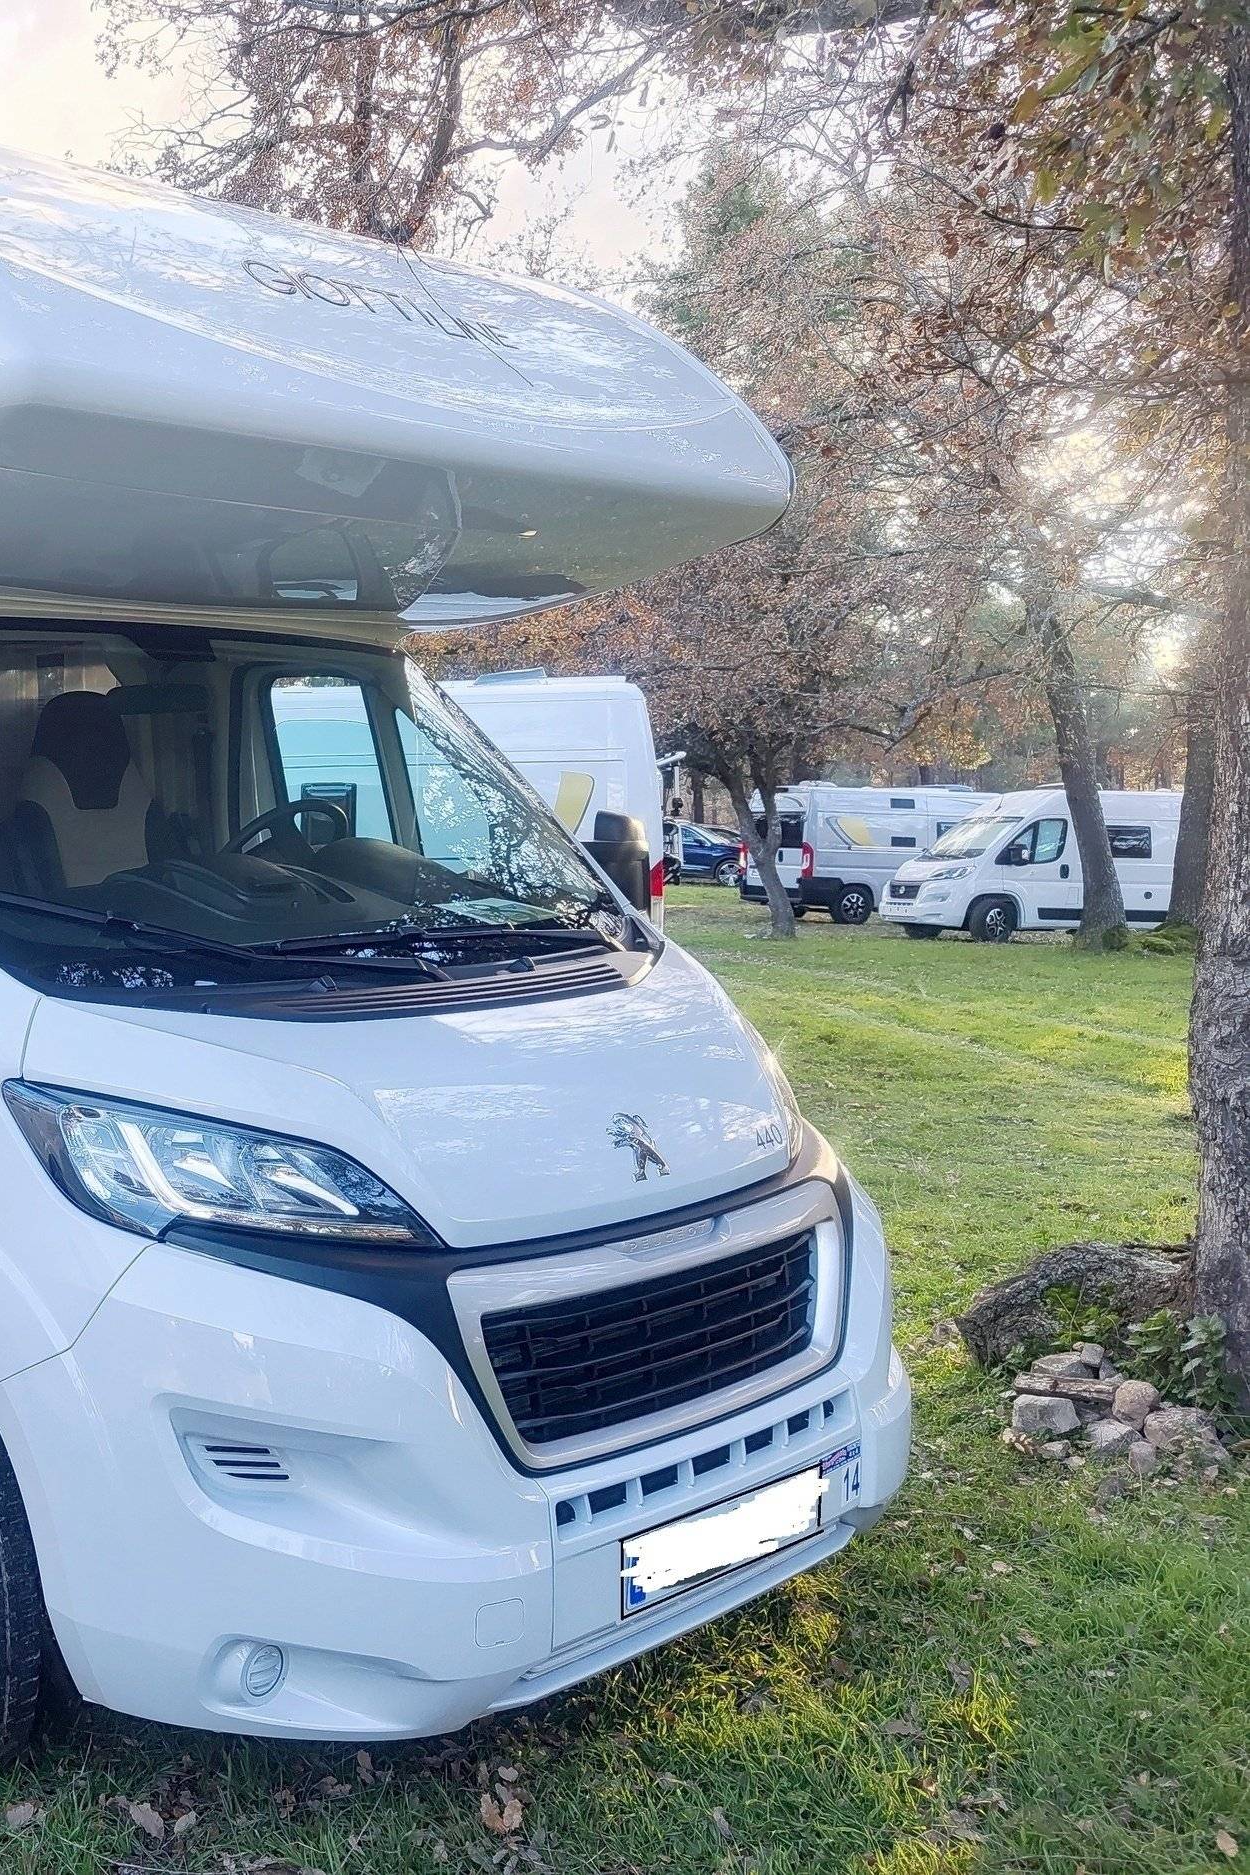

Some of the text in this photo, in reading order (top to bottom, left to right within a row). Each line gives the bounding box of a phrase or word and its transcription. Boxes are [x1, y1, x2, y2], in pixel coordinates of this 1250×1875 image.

[241, 260, 519, 349] GIOTTILINE
[756, 1124, 783, 1149] 440
[844, 1461, 860, 1501] 14
